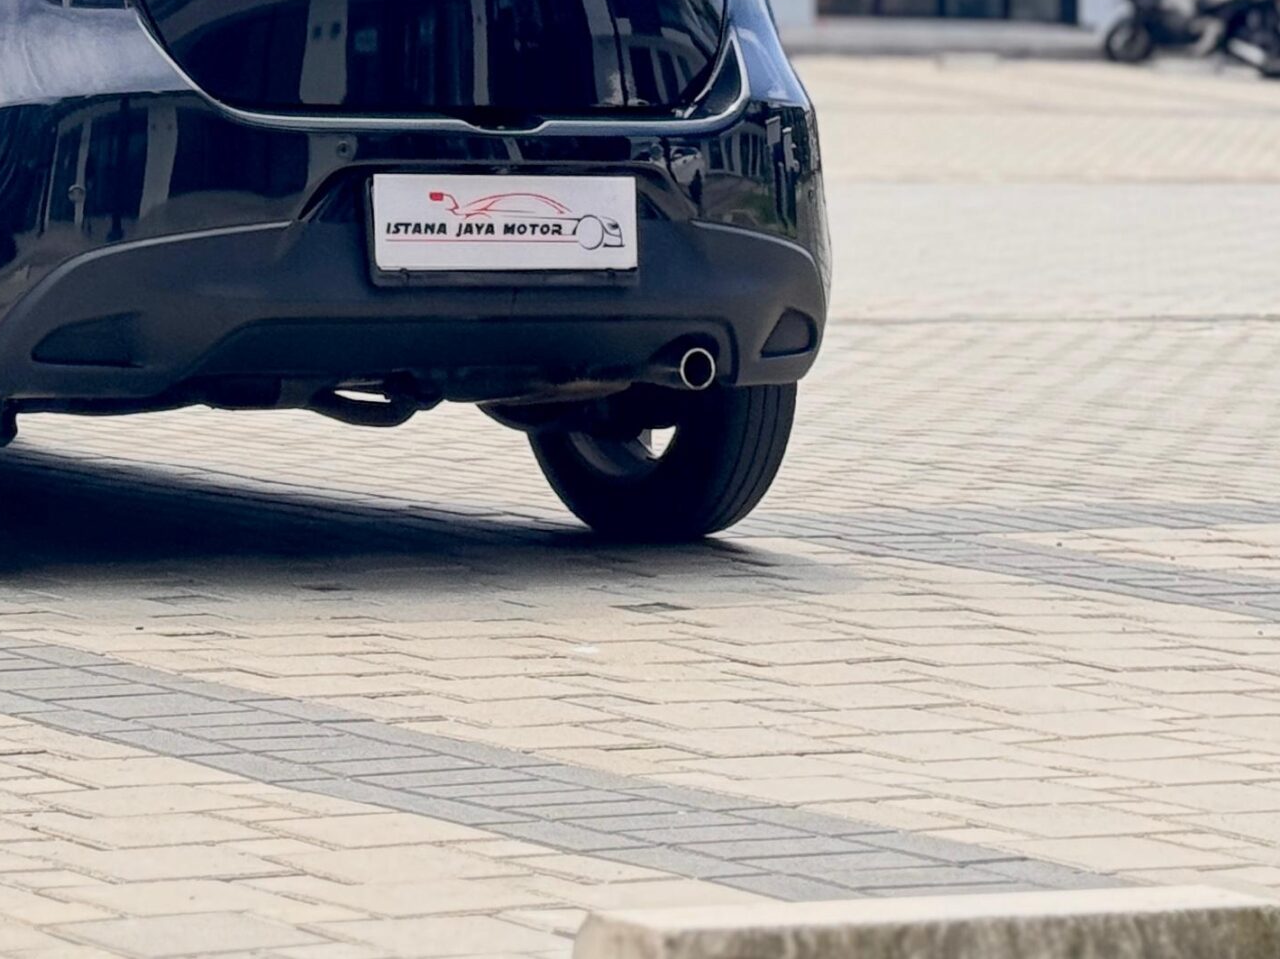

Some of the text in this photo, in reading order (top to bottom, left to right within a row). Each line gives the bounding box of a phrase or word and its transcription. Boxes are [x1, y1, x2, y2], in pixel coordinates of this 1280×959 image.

[385, 222, 563, 237] ISTANA JAYA MOTOR
